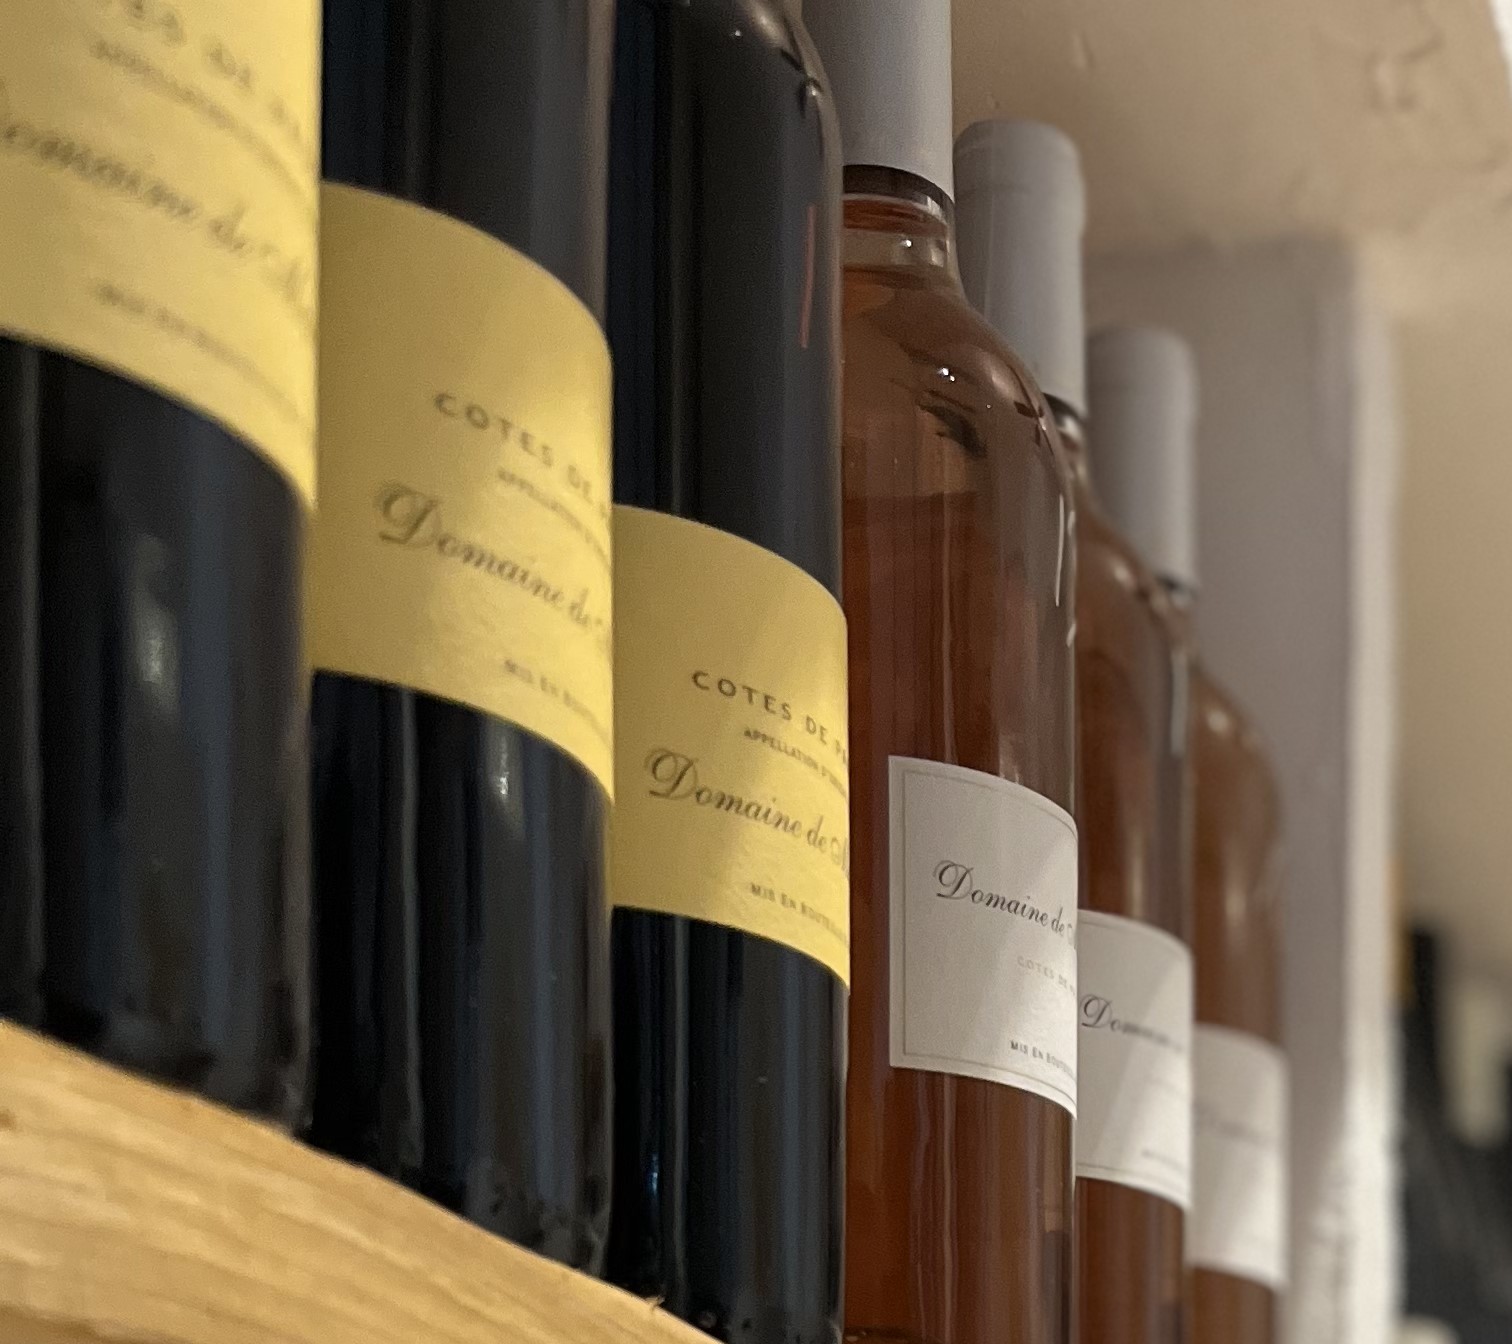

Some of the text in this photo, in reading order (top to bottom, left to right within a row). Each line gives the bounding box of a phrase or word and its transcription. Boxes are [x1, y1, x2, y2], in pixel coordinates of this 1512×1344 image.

[434, 392, 554, 467] COTES
[374, 482, 564, 612] Domaine
[692, 669, 828, 744] COTES DE
[644, 748, 802, 834] Domaine
[806, 814, 829, 854] de
[933, 859, 1050, 927] Domaine
[1050, 906, 1066, 938] de
